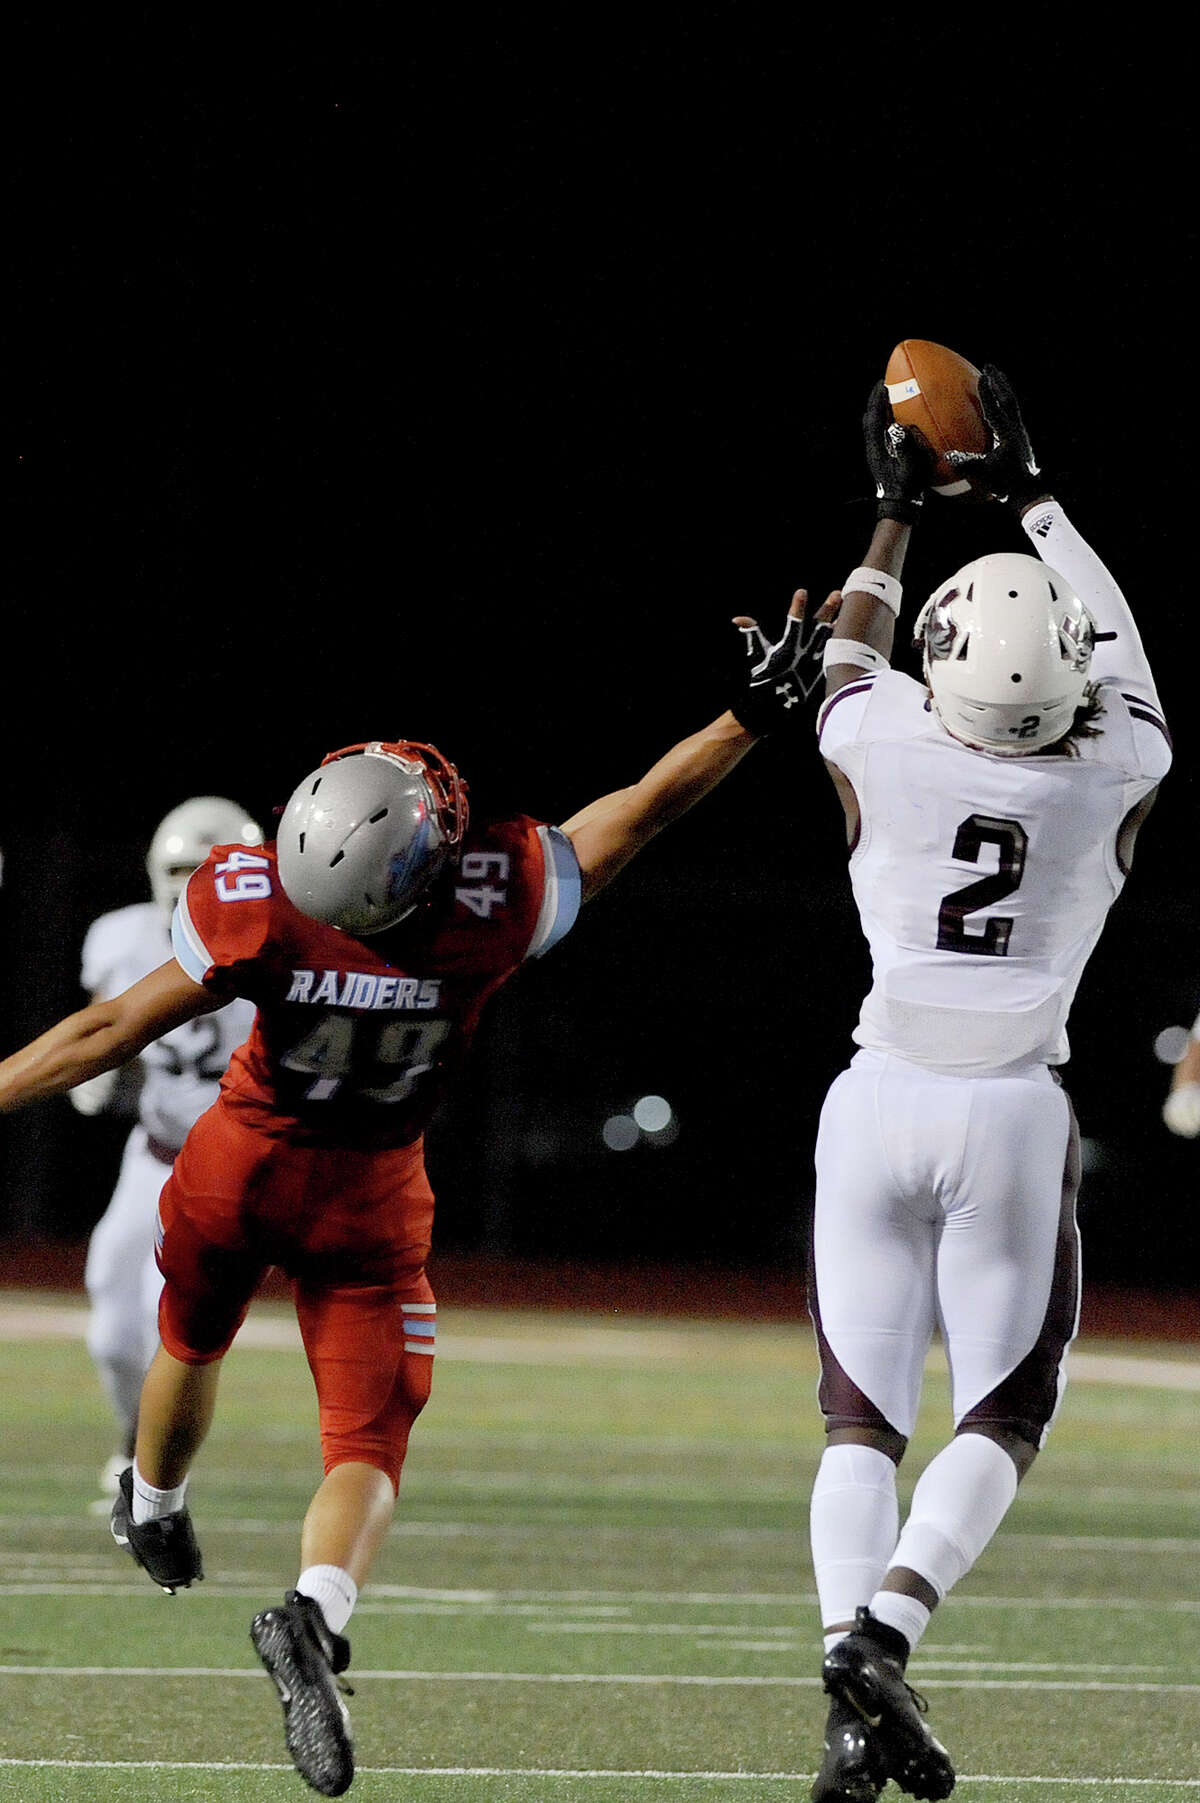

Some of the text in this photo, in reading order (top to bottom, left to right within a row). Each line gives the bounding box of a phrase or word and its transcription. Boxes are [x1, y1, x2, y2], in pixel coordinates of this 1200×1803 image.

[214, 850, 272, 903] 49
[455, 852, 509, 918] 49
[936, 813, 1029, 956] 2
[285, 969, 442, 1010] RAIDERS
[280, 1014, 450, 1103] 49
